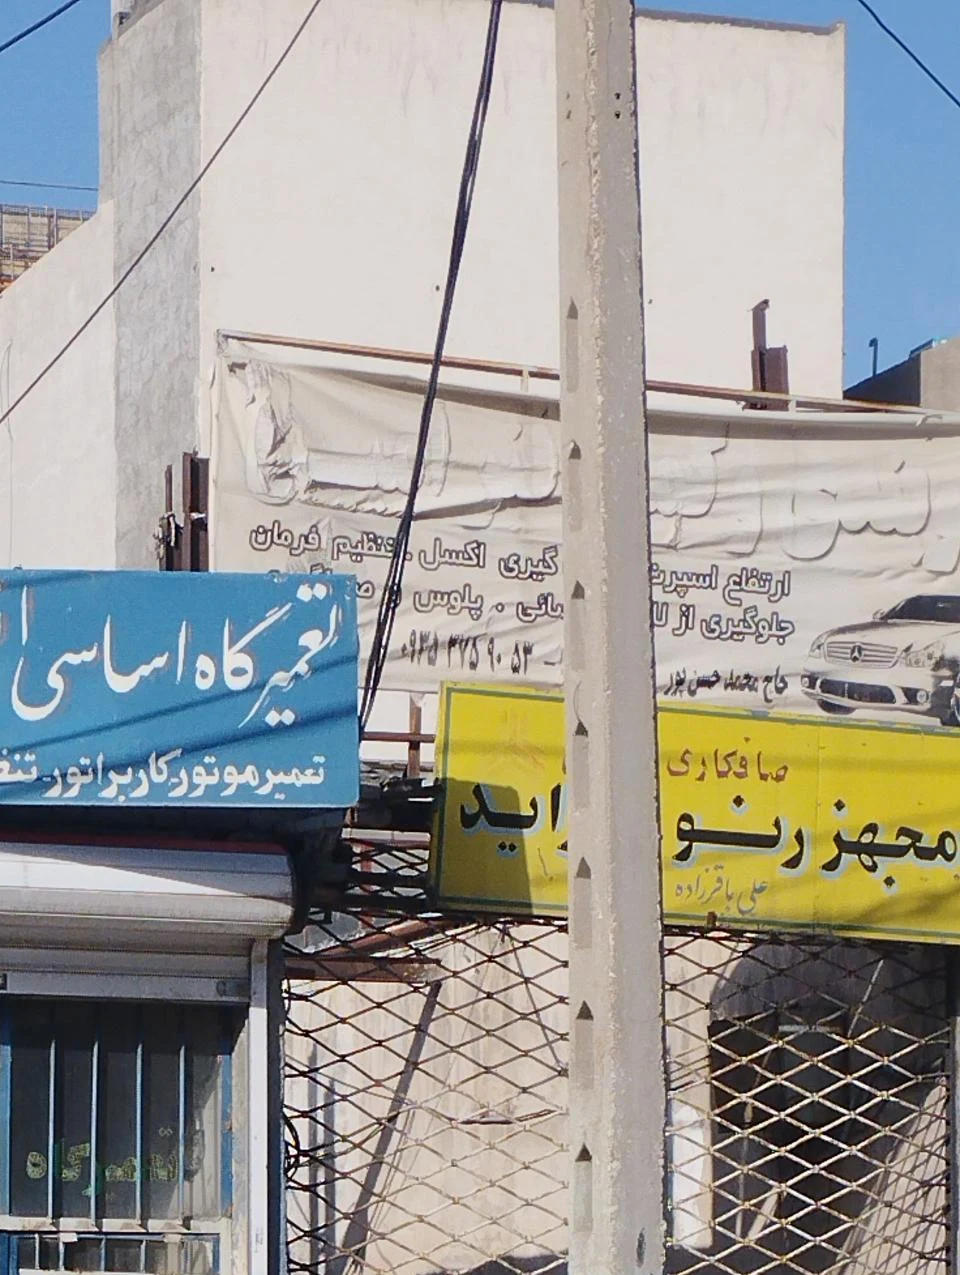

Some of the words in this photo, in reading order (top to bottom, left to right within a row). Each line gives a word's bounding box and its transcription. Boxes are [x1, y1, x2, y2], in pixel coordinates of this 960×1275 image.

[250, 520, 320, 555] فرمان
[331, 531, 400, 562] نظیم
[419, 537, 486, 569] اکسل
[498, 545, 558, 582] گیری
[413, 584, 483, 620] پلوس
[723, 567, 791, 606] ارتفاع
[672, 604, 695, 636] از
[700, 605, 795, 645] جلوگیری
[11, 616, 188, 721] اساسی
[194, 580, 340, 728] تعمیرگاه
[461, 783, 567, 852] اید
[672, 795, 804, 869] رنو
[821, 799, 957, 887] مجهز
